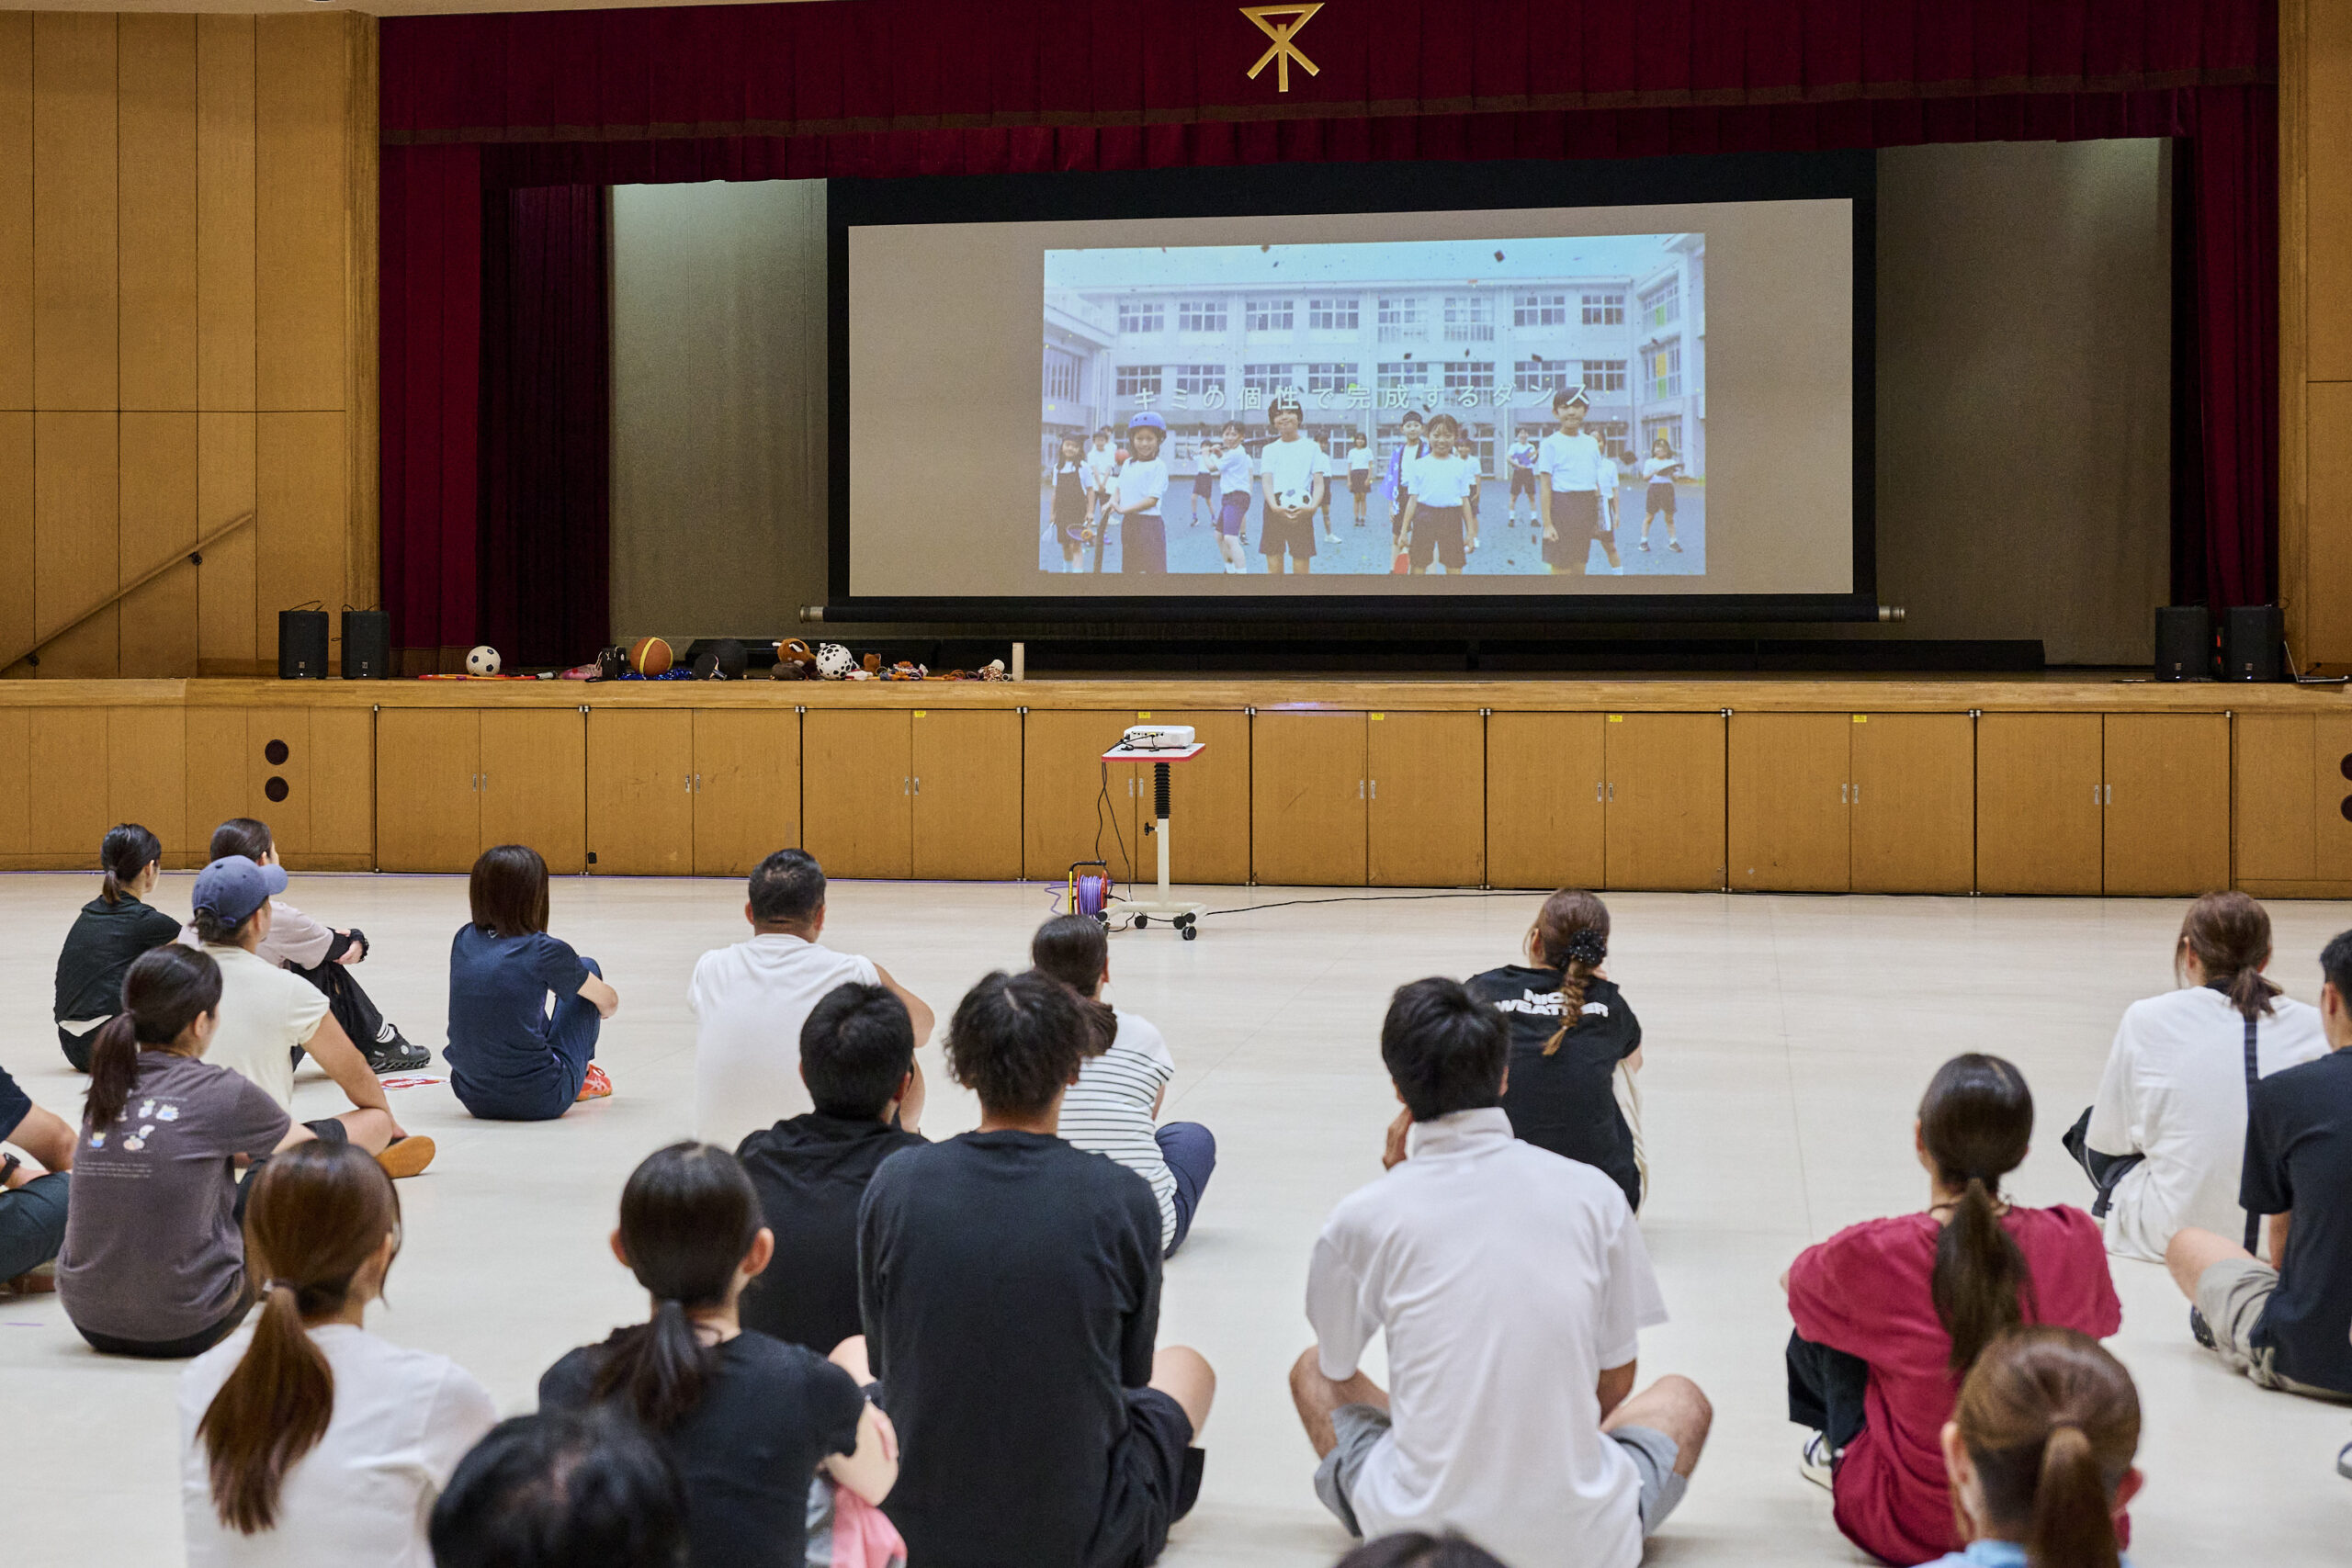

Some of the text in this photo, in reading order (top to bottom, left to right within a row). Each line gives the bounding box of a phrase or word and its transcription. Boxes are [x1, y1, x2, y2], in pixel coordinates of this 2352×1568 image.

[1134, 383, 1589, 411] キミの個性で完成するダンス
[1523, 988, 1568, 1005] NIC
